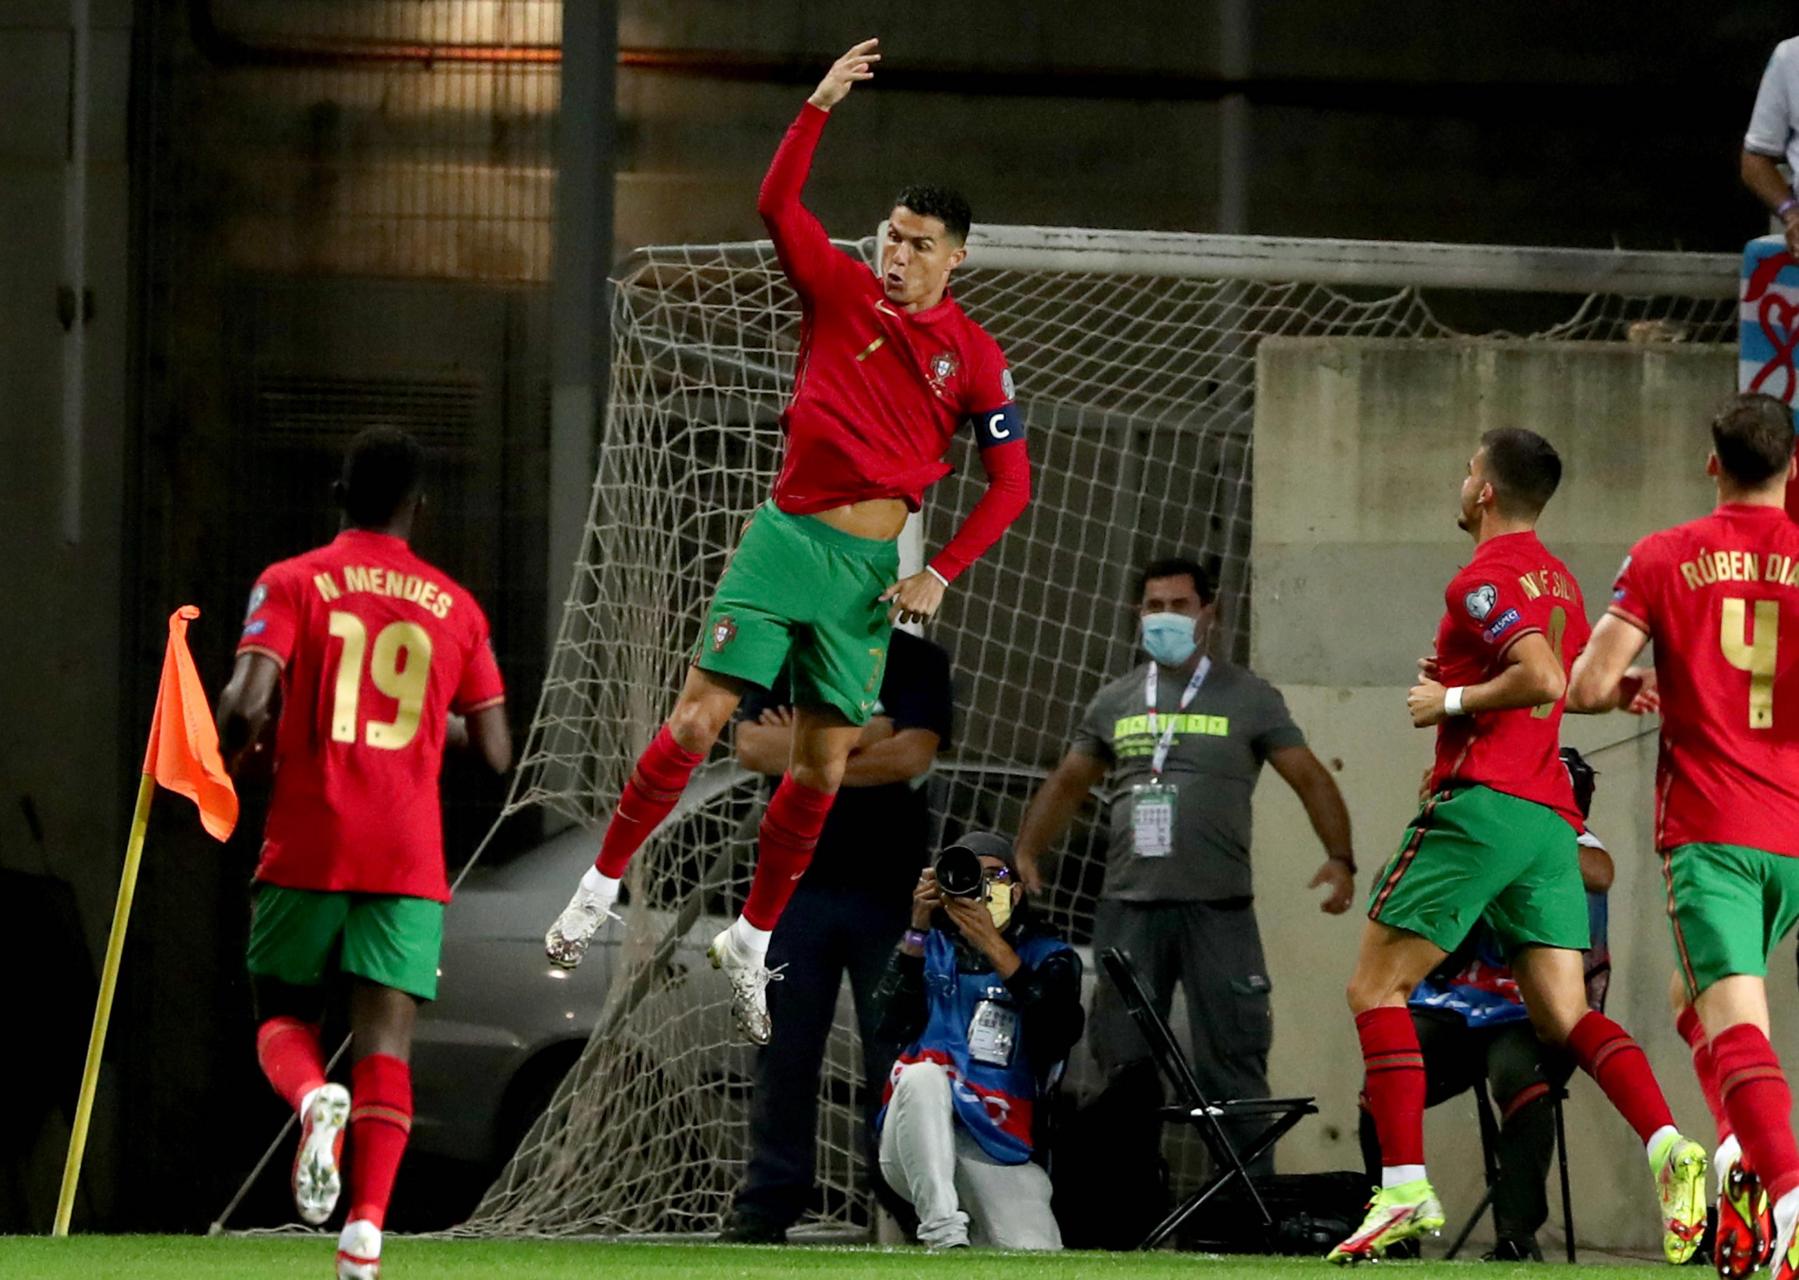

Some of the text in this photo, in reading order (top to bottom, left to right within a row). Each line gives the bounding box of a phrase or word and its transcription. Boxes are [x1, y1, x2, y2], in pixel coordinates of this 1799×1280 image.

[989, 413, 1010, 439] C
[343, 565, 453, 619] MENDES
[1680, 547, 1760, 591] RÚBEN
[329, 611, 432, 749] 19
[1721, 597, 1779, 728] 4
